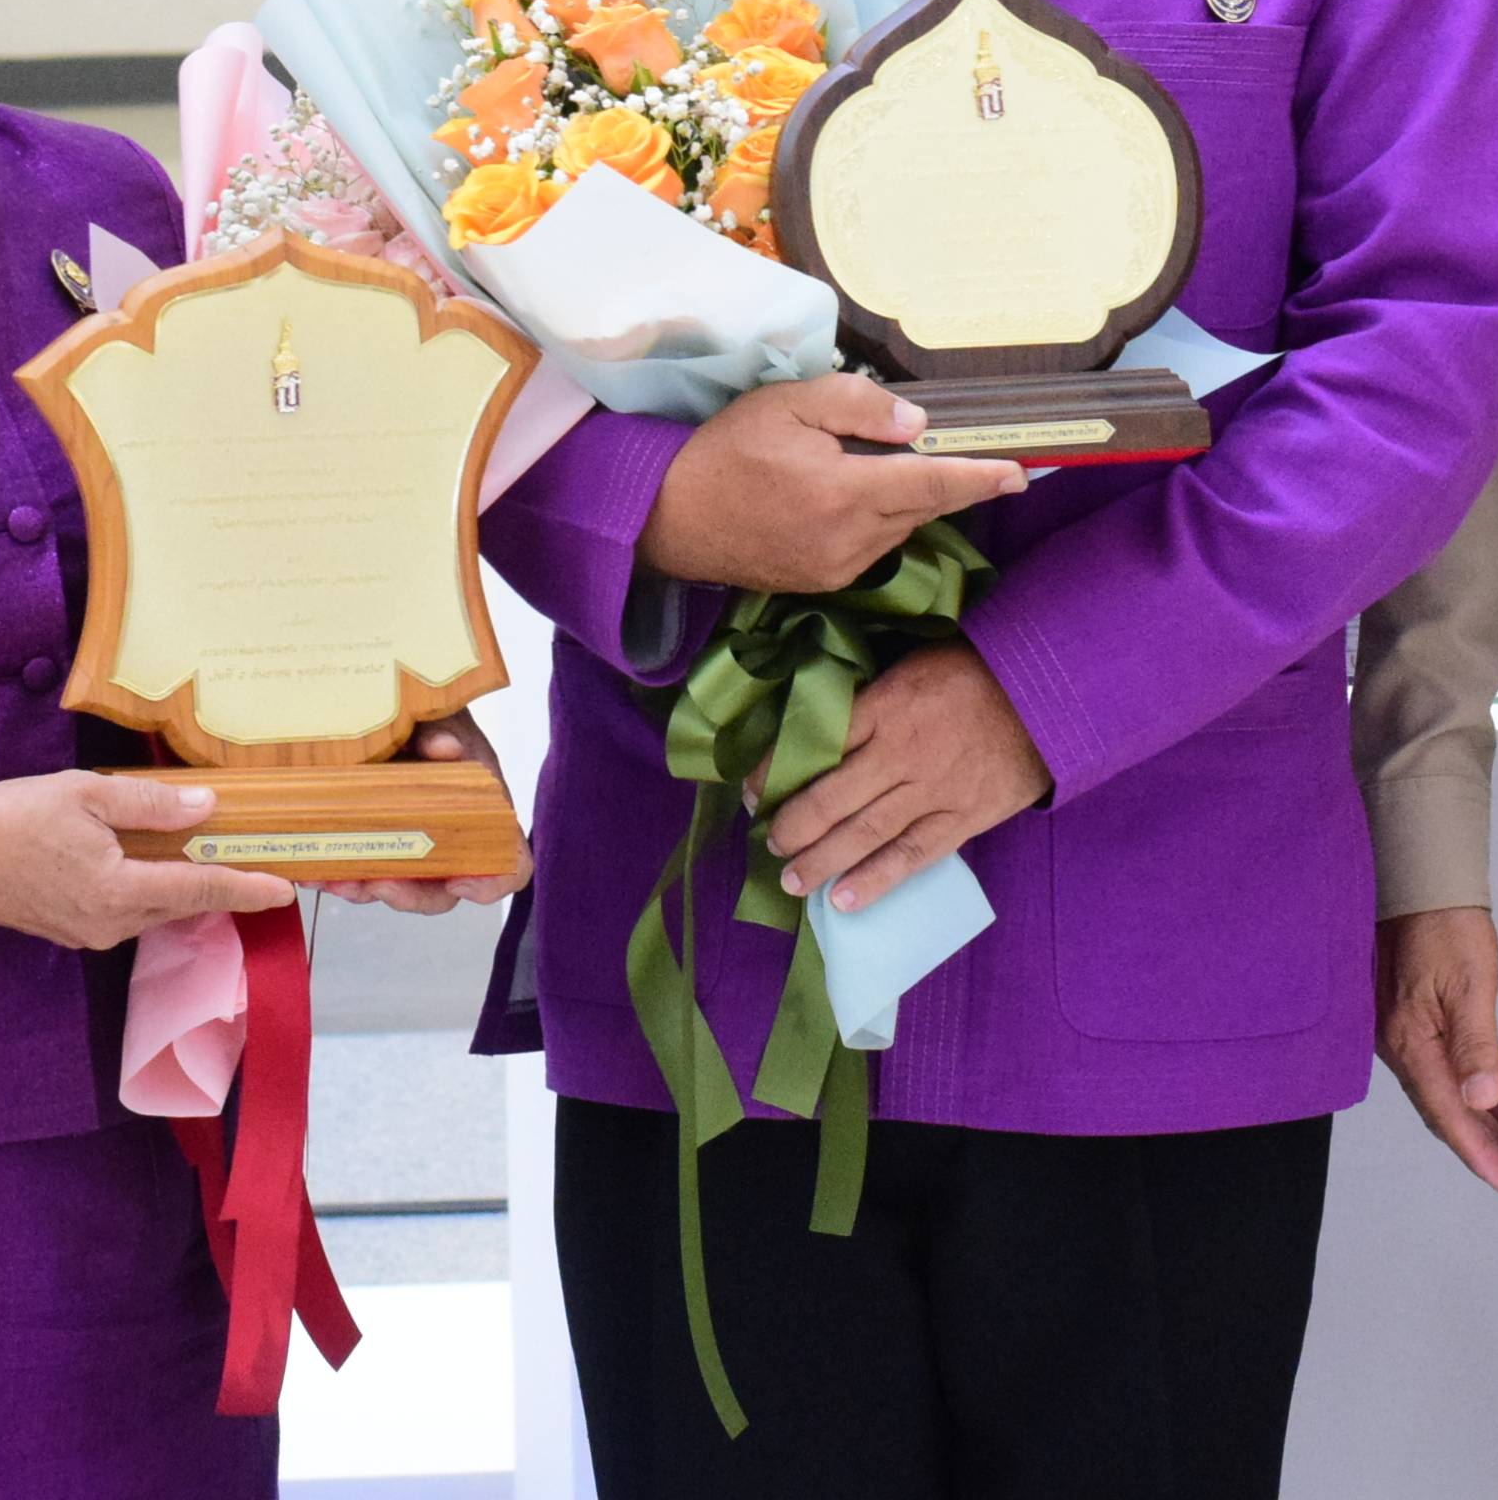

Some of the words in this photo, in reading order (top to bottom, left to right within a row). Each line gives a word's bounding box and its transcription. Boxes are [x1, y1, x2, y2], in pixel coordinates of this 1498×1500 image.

[223, 840, 320, 857] กรมการพัฒนาชุมชน
[324, 837, 416, 854] กระทรวงมหาดไทย
